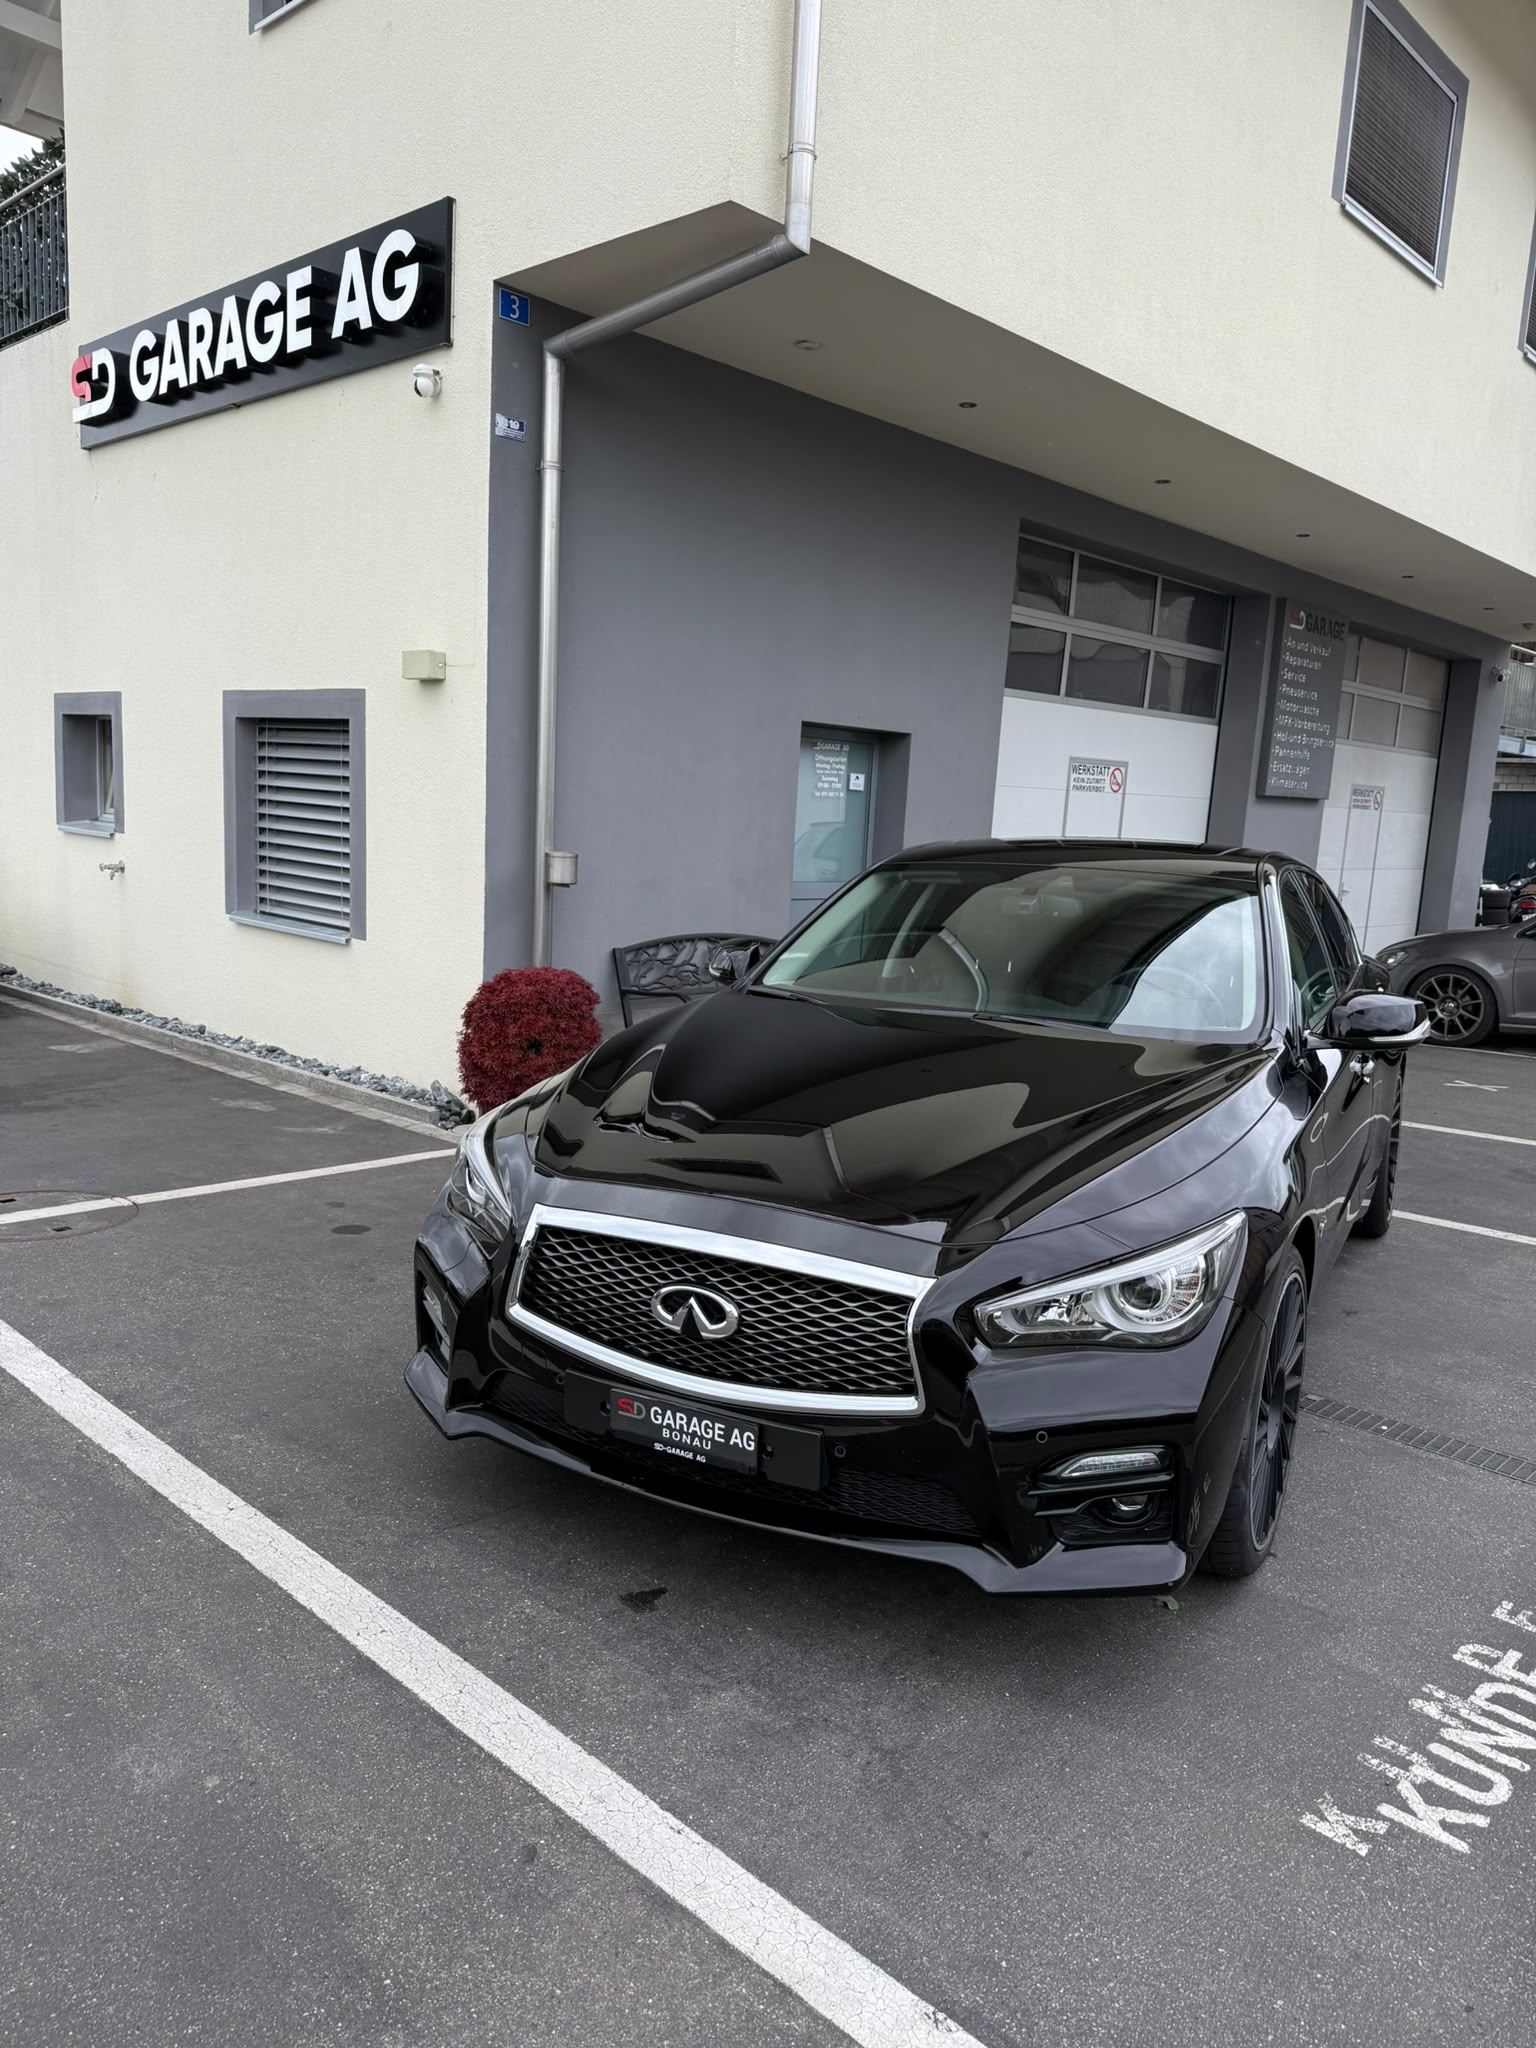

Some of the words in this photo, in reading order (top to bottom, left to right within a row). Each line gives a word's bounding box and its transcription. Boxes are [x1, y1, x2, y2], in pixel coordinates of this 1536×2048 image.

[509, 295, 520, 319] 3
[71, 347, 116, 423] SD
[129, 265, 312, 402] GARAGE
[331, 229, 421, 339] AG
[1306, 613, 1345, 641] GARAGE
[1284, 668, 1306, 683] Service
[1071, 764, 1111, 777] WERKSTATT
[1071, 784, 1106, 793] PARKVERBOT
[1086, 777, 1106, 785] ZUTRITT
[650, 1406, 725, 1442] GARAGE
[729, 1428, 755, 1451] AG
[662, 1428, 711, 1450] BONAU
[696, 1454, 706, 1463] AG
